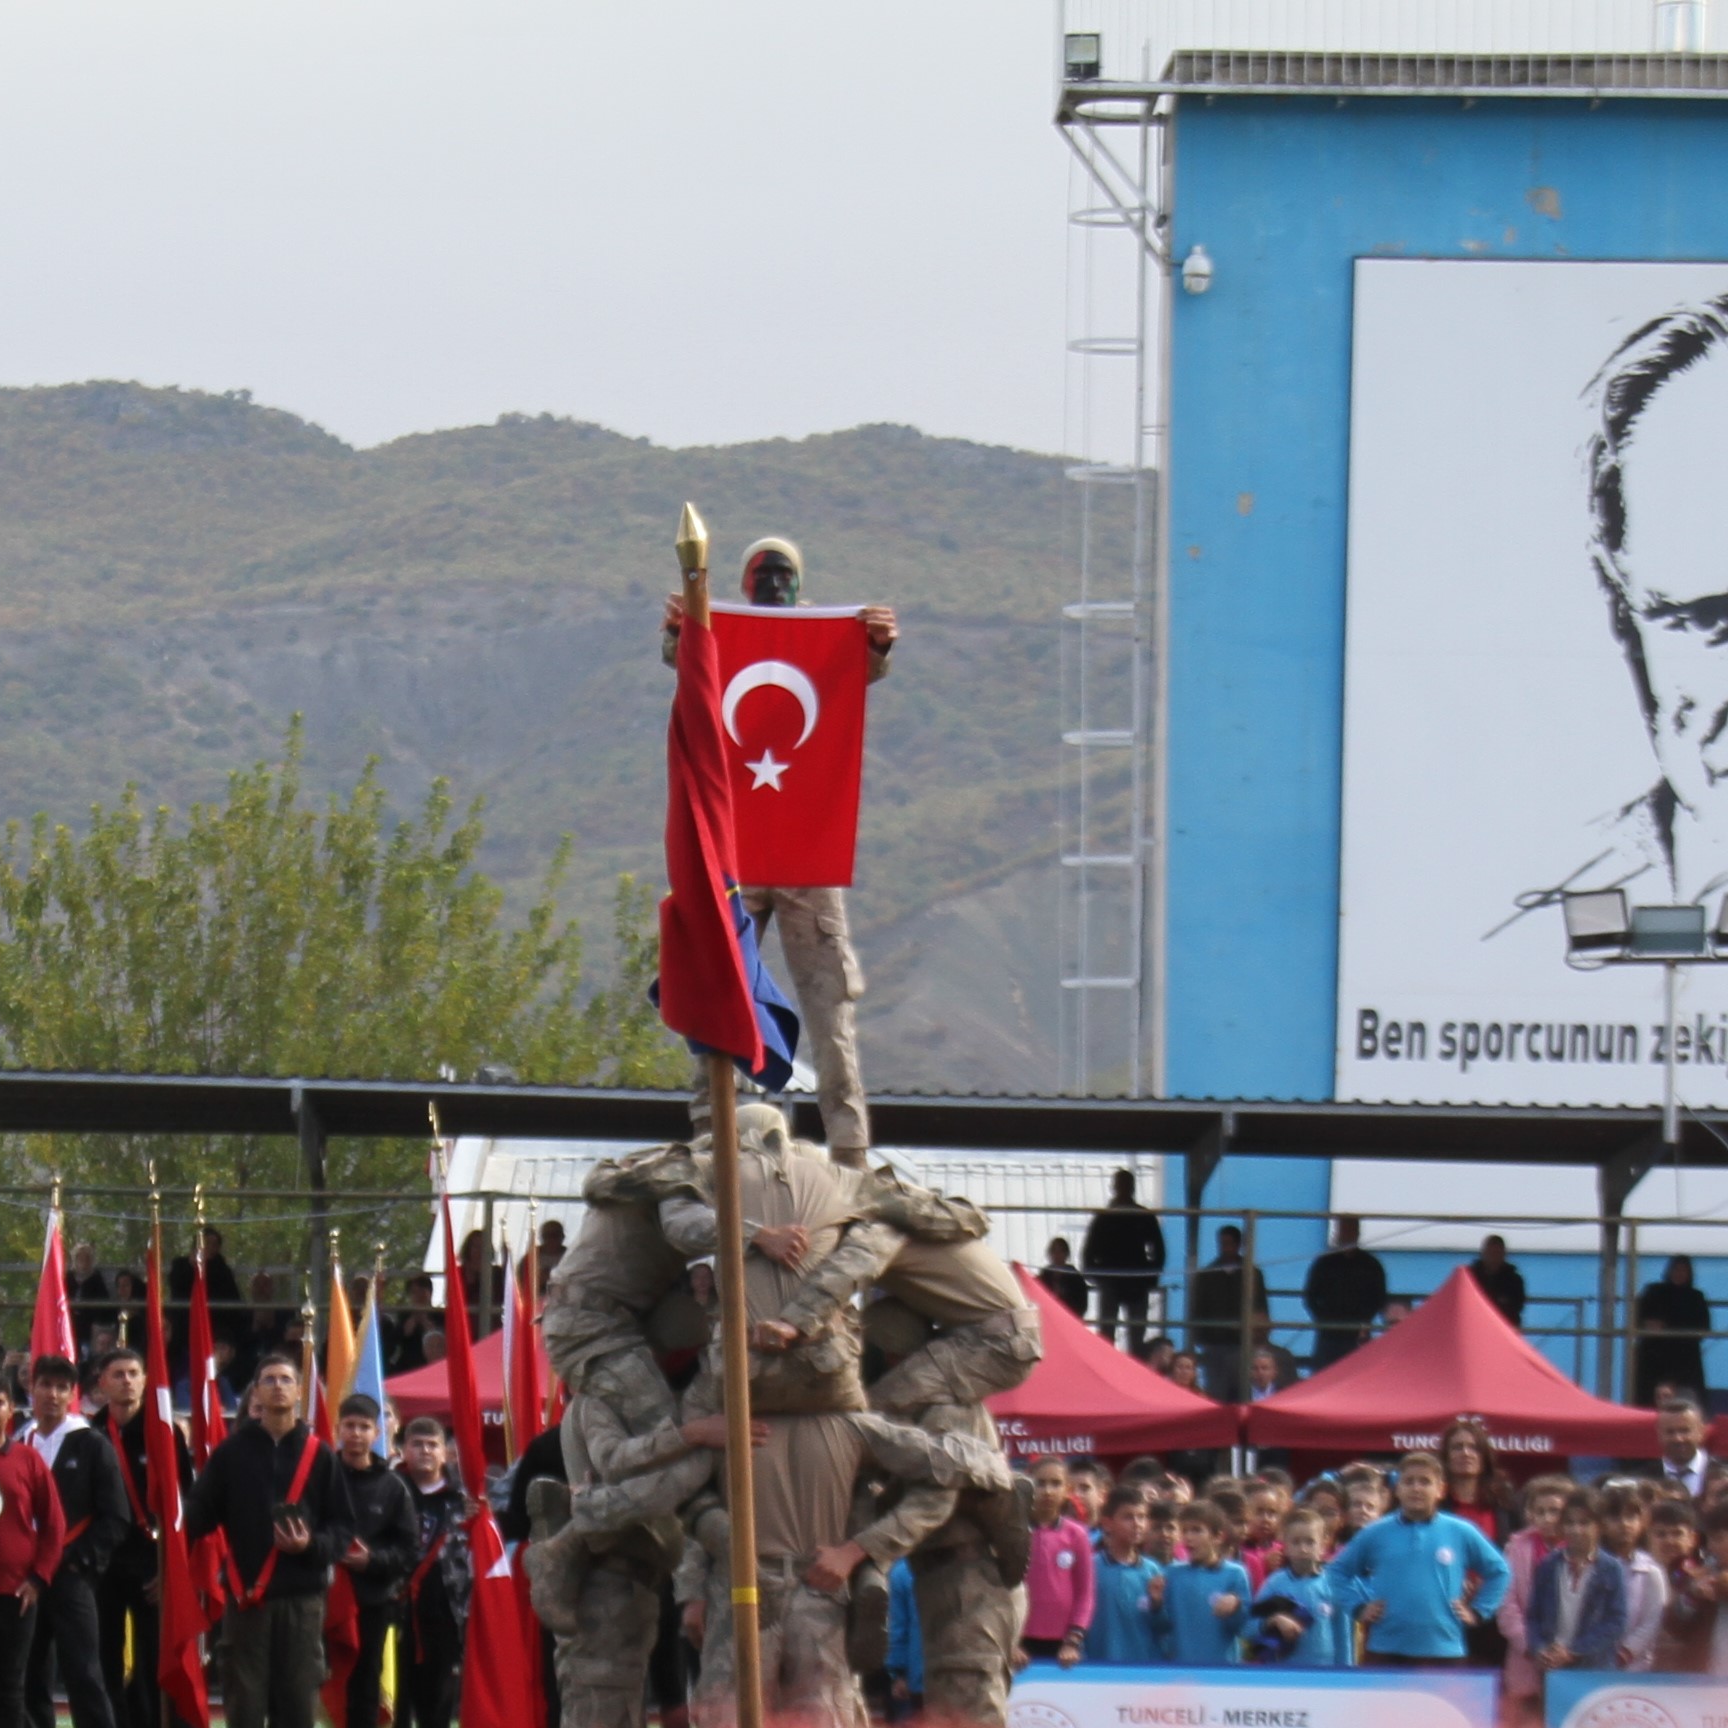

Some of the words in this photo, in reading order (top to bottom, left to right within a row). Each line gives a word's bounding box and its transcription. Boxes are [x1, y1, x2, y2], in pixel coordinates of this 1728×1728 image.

[1355, 1008, 1427, 1061] Ben
[1438, 1019, 1638, 1074] sporcunun
[1391, 1434, 1443, 1450] TUNC
[1485, 1434, 1550, 1452] ALİLİĞİ
[1115, 1704, 1205, 1726] TUNCELİ
[1223, 1708, 1310, 1728] MERKEZ
